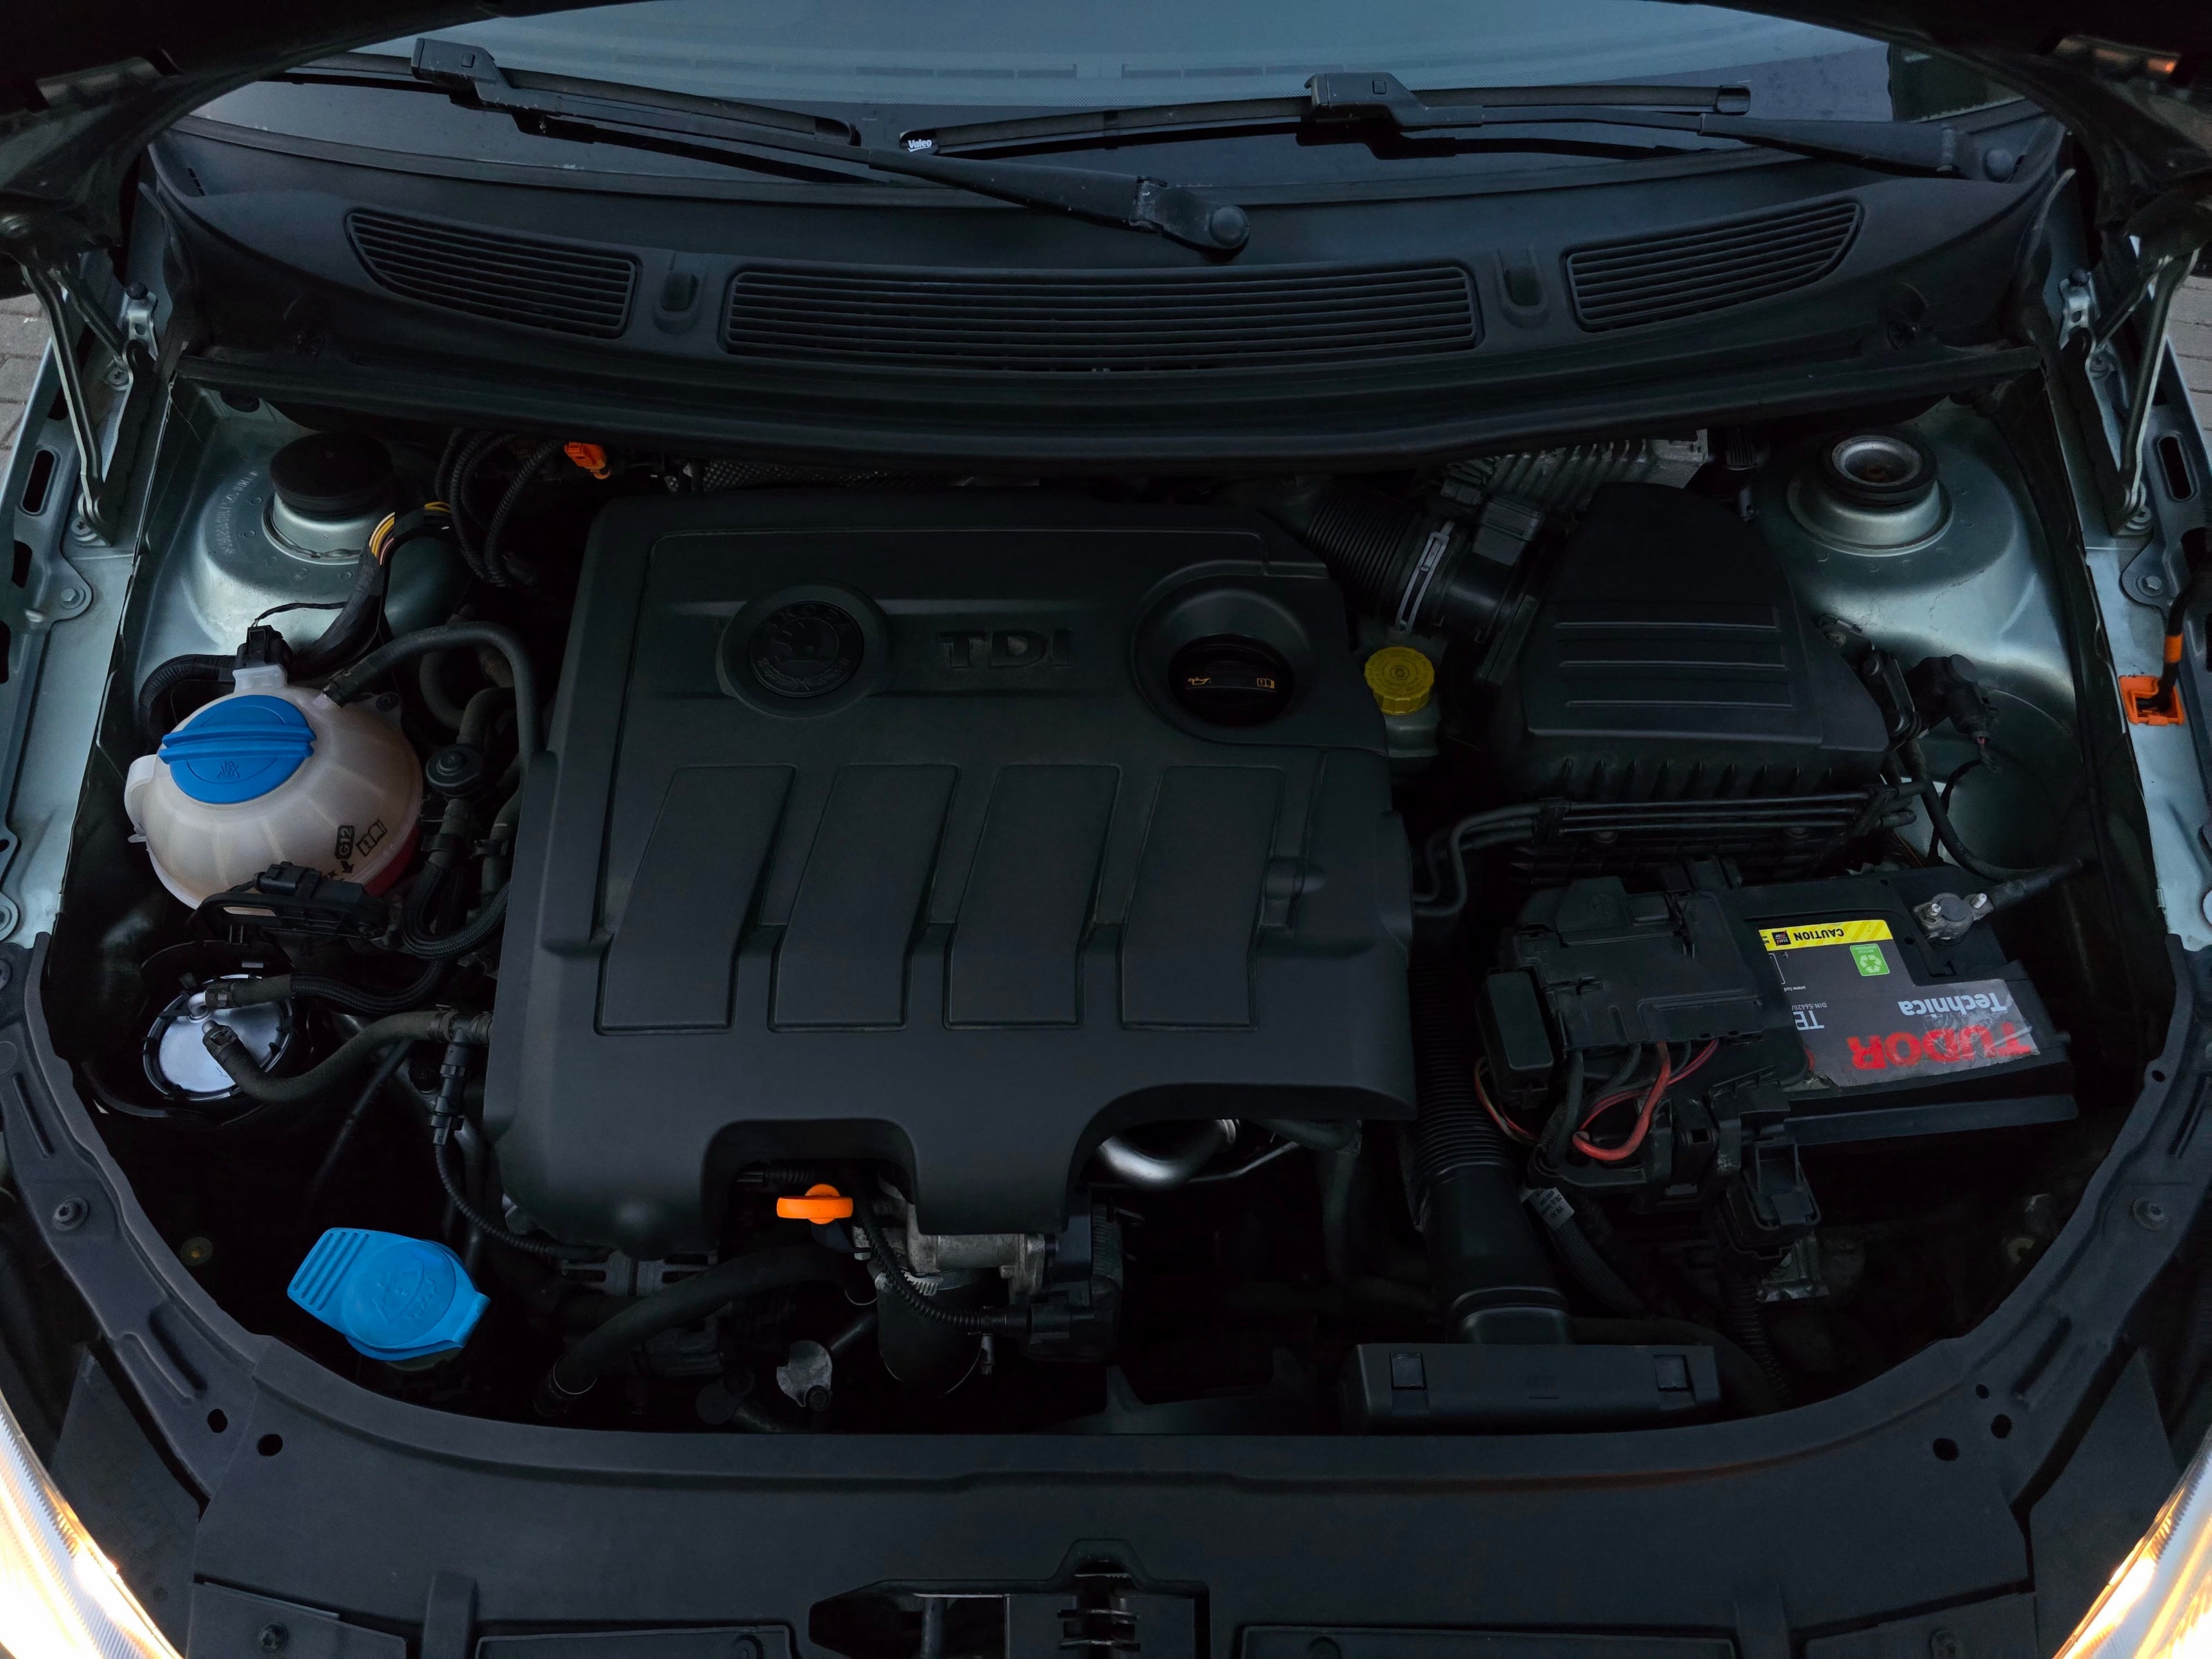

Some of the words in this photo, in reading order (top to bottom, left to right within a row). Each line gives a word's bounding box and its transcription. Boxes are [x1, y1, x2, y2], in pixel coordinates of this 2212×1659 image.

[907, 138, 932, 149] Valeo
[937, 629, 1071, 670] TDI
[339, 827, 353, 856] G12
[1793, 928, 1844, 941] CAUTION
[1897, 992, 2008, 1018] Technica
[1846, 1022, 2032, 1069] TUDOR
